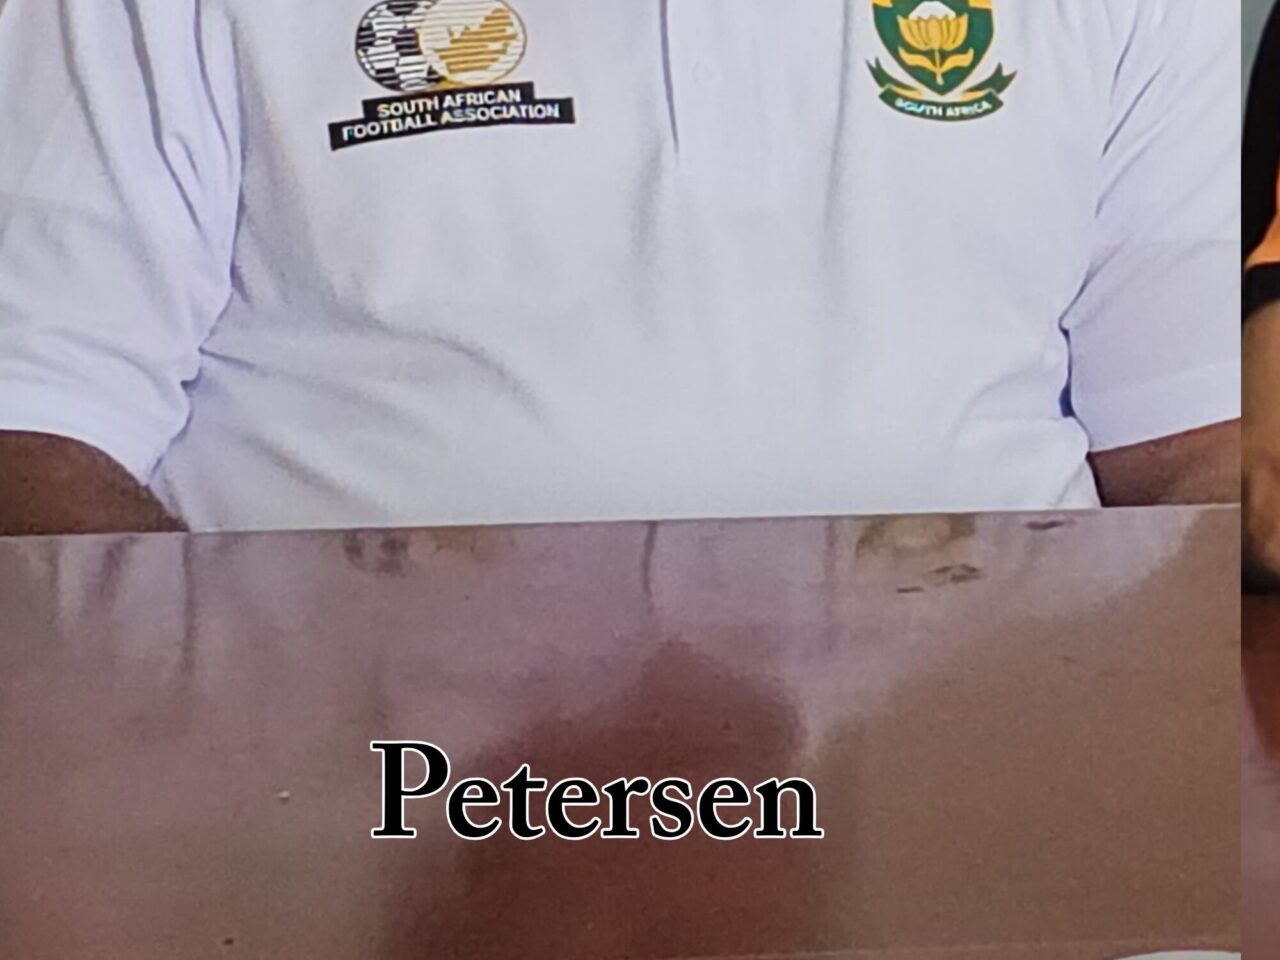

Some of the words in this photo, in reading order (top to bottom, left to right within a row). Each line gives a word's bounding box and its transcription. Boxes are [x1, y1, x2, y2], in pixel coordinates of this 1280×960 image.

[376, 95, 440, 119] SOUTH
[442, 89, 521, 109] AFRICAN
[895, 98, 943, 117] SOUTH
[342, 113, 438, 141] FOOTBALL
[440, 103, 560, 125] ASSOCIATION
